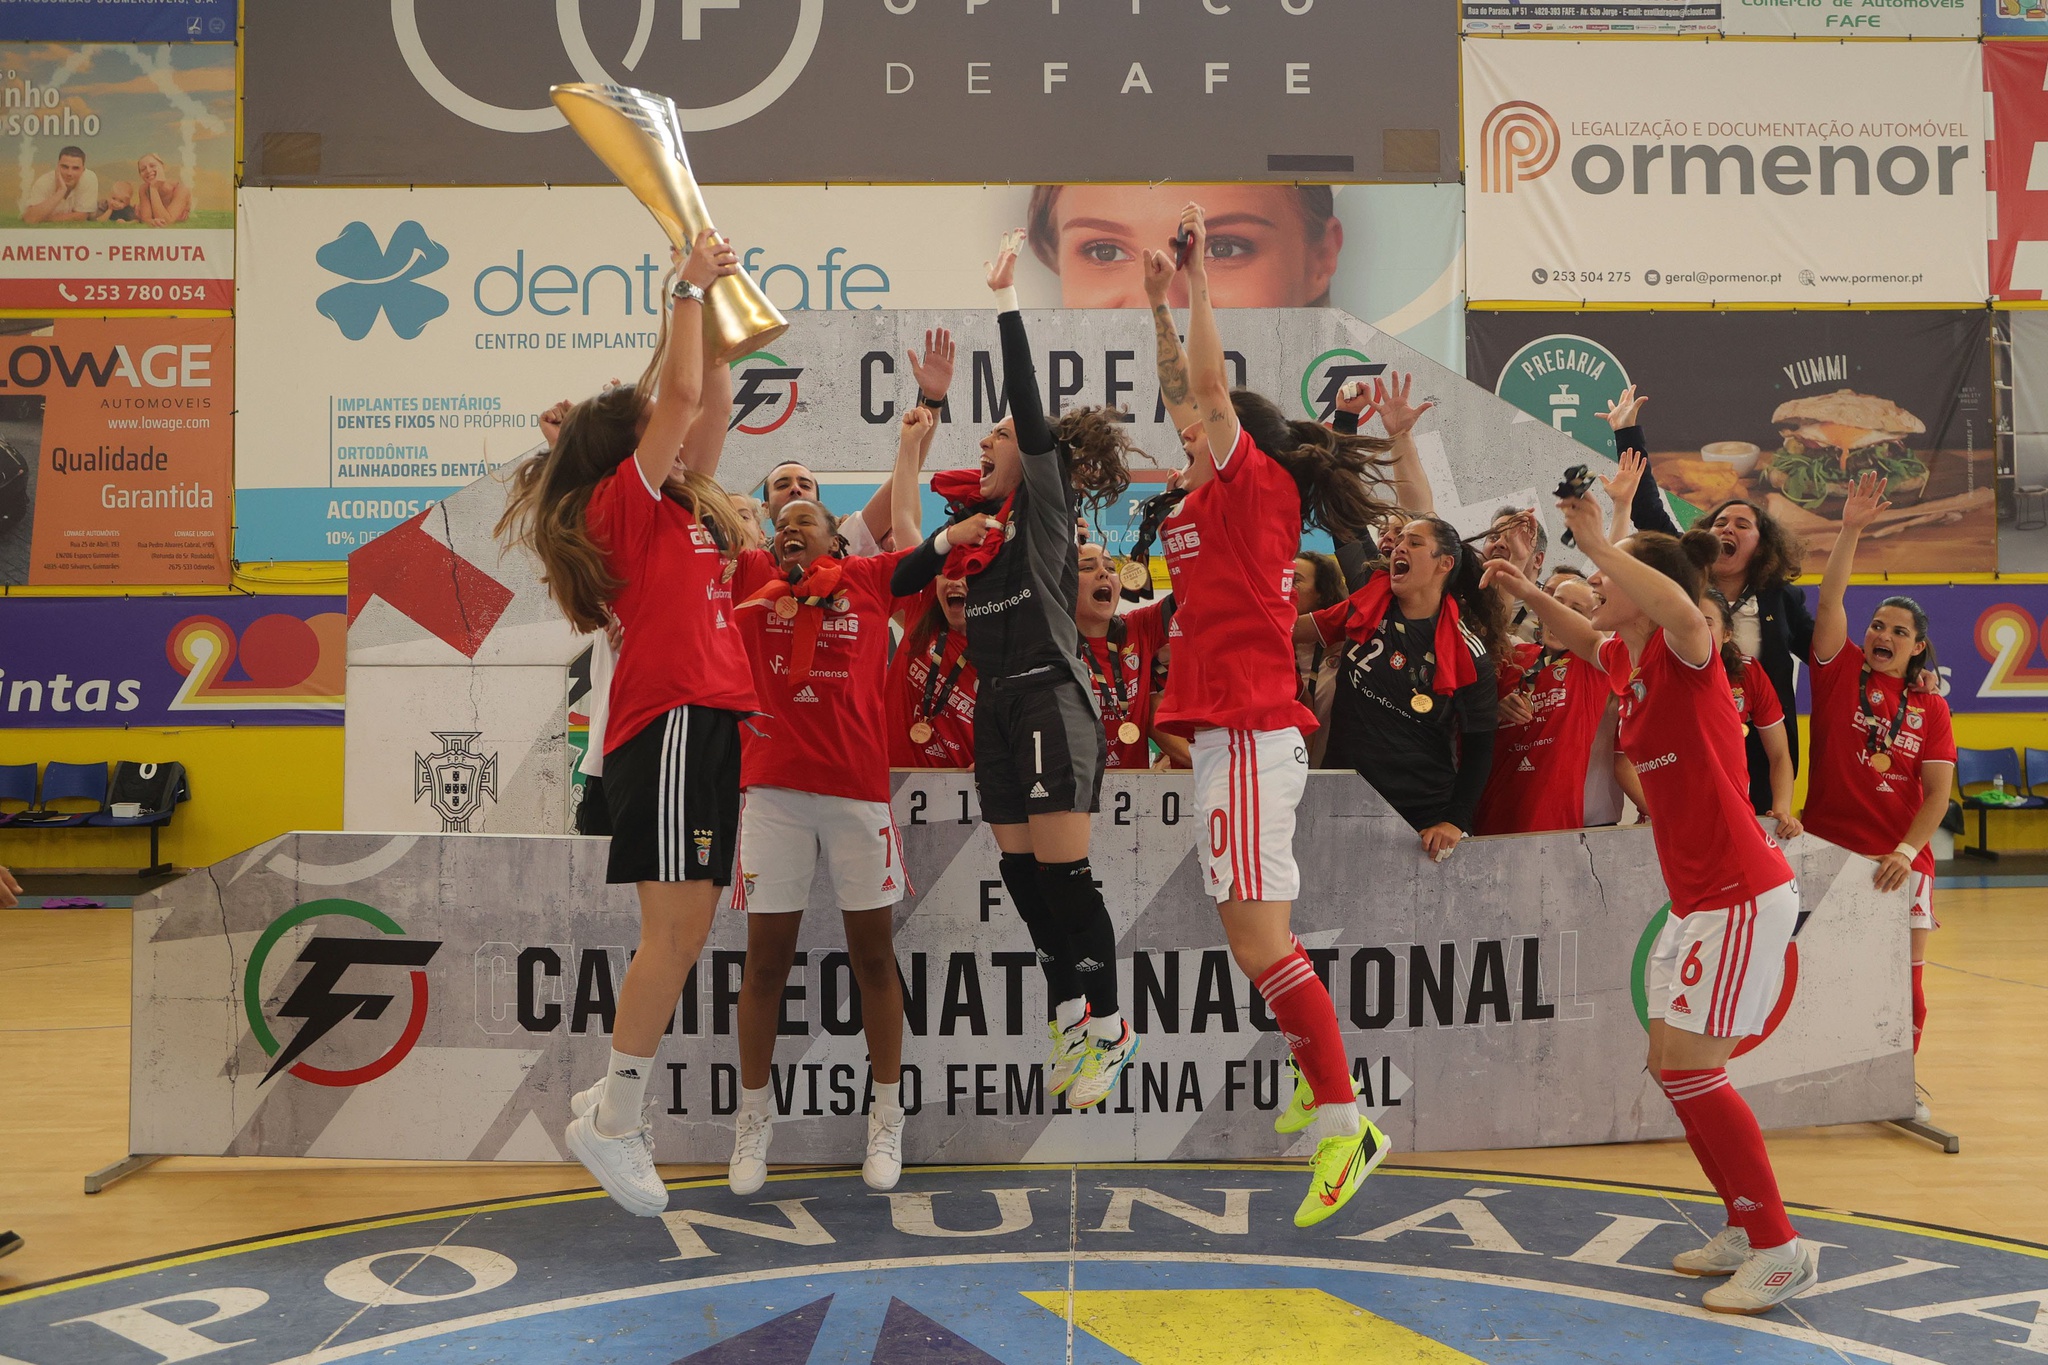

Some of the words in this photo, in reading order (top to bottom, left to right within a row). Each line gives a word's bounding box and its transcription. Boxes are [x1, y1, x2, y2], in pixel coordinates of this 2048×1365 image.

[1468, 7, 1478, 15] Rua
[1480, 7, 1487, 15] do
[1520, 7, 1527, 15] 51
[1562, 7, 1575, 15] FAFE
[1602, 8, 1618, 16] Jorge
[1826, 15, 1881, 28] FAFE
[8, 108, 100, 136] sonho
[1571, 118, 1687, 140] LEGALIZAÇÃO
[1693, 122, 1702, 137] E
[1708, 119, 1853, 142] DOCUMENTAÇÃO
[1858, 119, 1969, 138] AUTOMÓVEL
[109, 246, 206, 262] PERMUTA
[473, 247, 890, 316] dentfafe
[1552, 270, 1576, 283] 253
[1579, 270, 1603, 283] 504
[1607, 270, 1631, 283] 275
[1664, 271, 1782, 286] geral@pormenor.pt
[1820, 272, 1924, 285] www.pormenor.pt
[84, 285, 120, 301] 253
[127, 285, 163, 301] 780
[169, 285, 206, 301] 054
[475, 333, 539, 350] CENTRO
[546, 333, 567, 350] DE
[1521, 349, 1606, 381] PREGARIA
[1783, 355, 1848, 390] YUMMI
[337, 398, 418, 411] IMPLANTES
[422, 394, 501, 411] DENTÁRIOS
[108, 416, 210, 431] www.lowage.com
[337, 415, 391, 429] DENTES
[395, 415, 435, 429] FIXOS
[439, 415, 459, 428] NO
[464, 410, 526, 428] PRÓPRIO
[337, 443, 429, 460] ORTODÔNTIA
[52, 446, 168, 475] Qualidade
[338, 463, 437, 478] ALINHADORES
[102, 482, 213, 508] Garantida
[326, 500, 420, 520] ACORDOS
[326, 531, 355, 545] 10%
[1032, 731, 1042, 774] 1
[1680, 940, 1703, 986] 6
[1671, 1004, 1692, 1014] adidas
[666, 1063, 688, 1115] I
